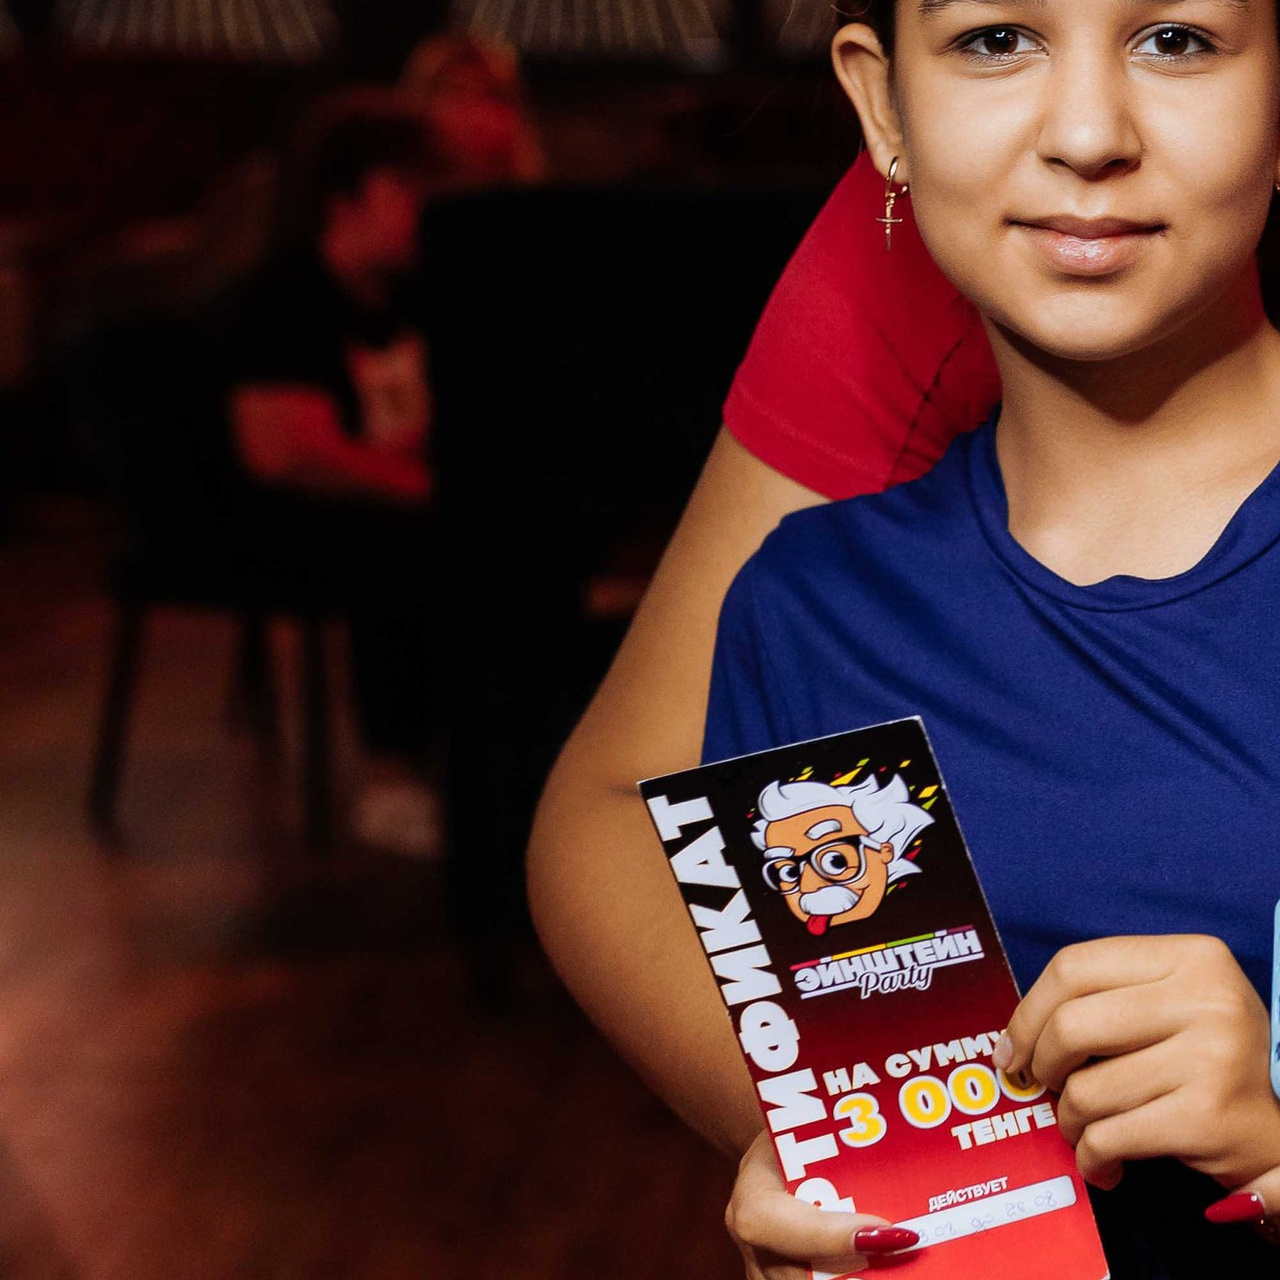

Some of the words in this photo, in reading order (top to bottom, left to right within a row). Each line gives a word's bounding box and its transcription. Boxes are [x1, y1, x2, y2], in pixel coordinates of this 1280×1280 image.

[793, 928, 983, 993] ЭЙНШТЕЙН
[857, 961, 933, 1000] Party
[821, 1062, 881, 1097] НА
[833, 1092, 887, 1148] 3
[950, 1102, 1057, 1151] ТЕНГЕ
[928, 1176, 1009, 1213] ДЕЙСТВУЕТ
